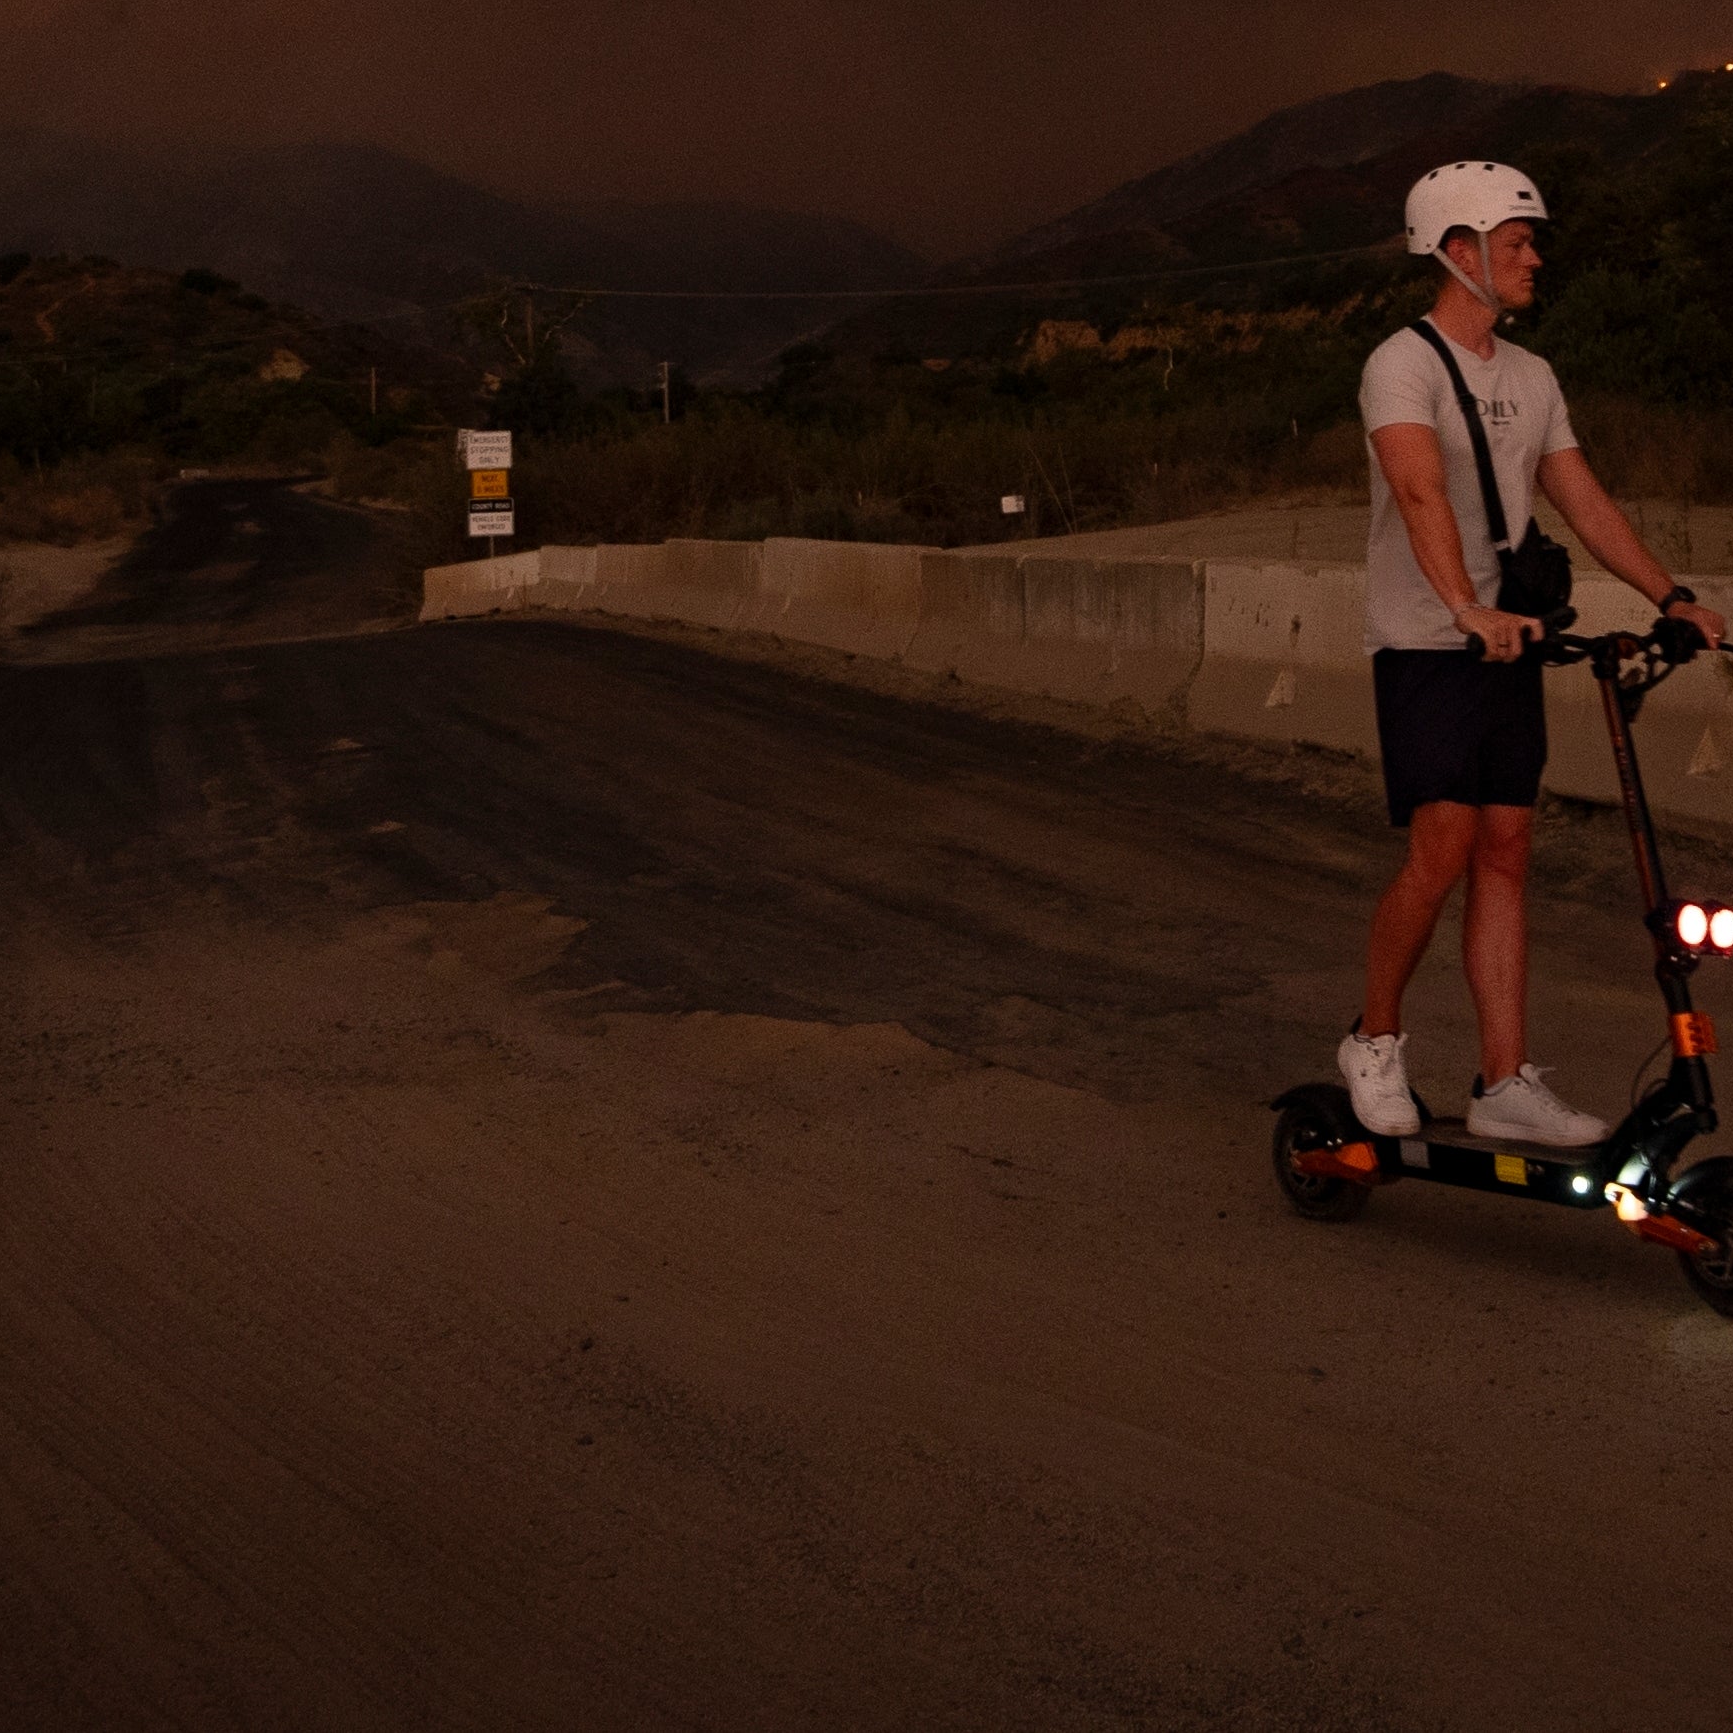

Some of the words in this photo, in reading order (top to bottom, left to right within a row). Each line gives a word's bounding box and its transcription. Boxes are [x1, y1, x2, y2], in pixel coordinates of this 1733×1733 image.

[469, 435, 508, 444] EMERGENCY
[470, 446, 508, 454] STOPPING
[478, 456, 500, 464] ONLY
[471, 502, 493, 510] COUNTY
[494, 501, 511, 509] ROAD
